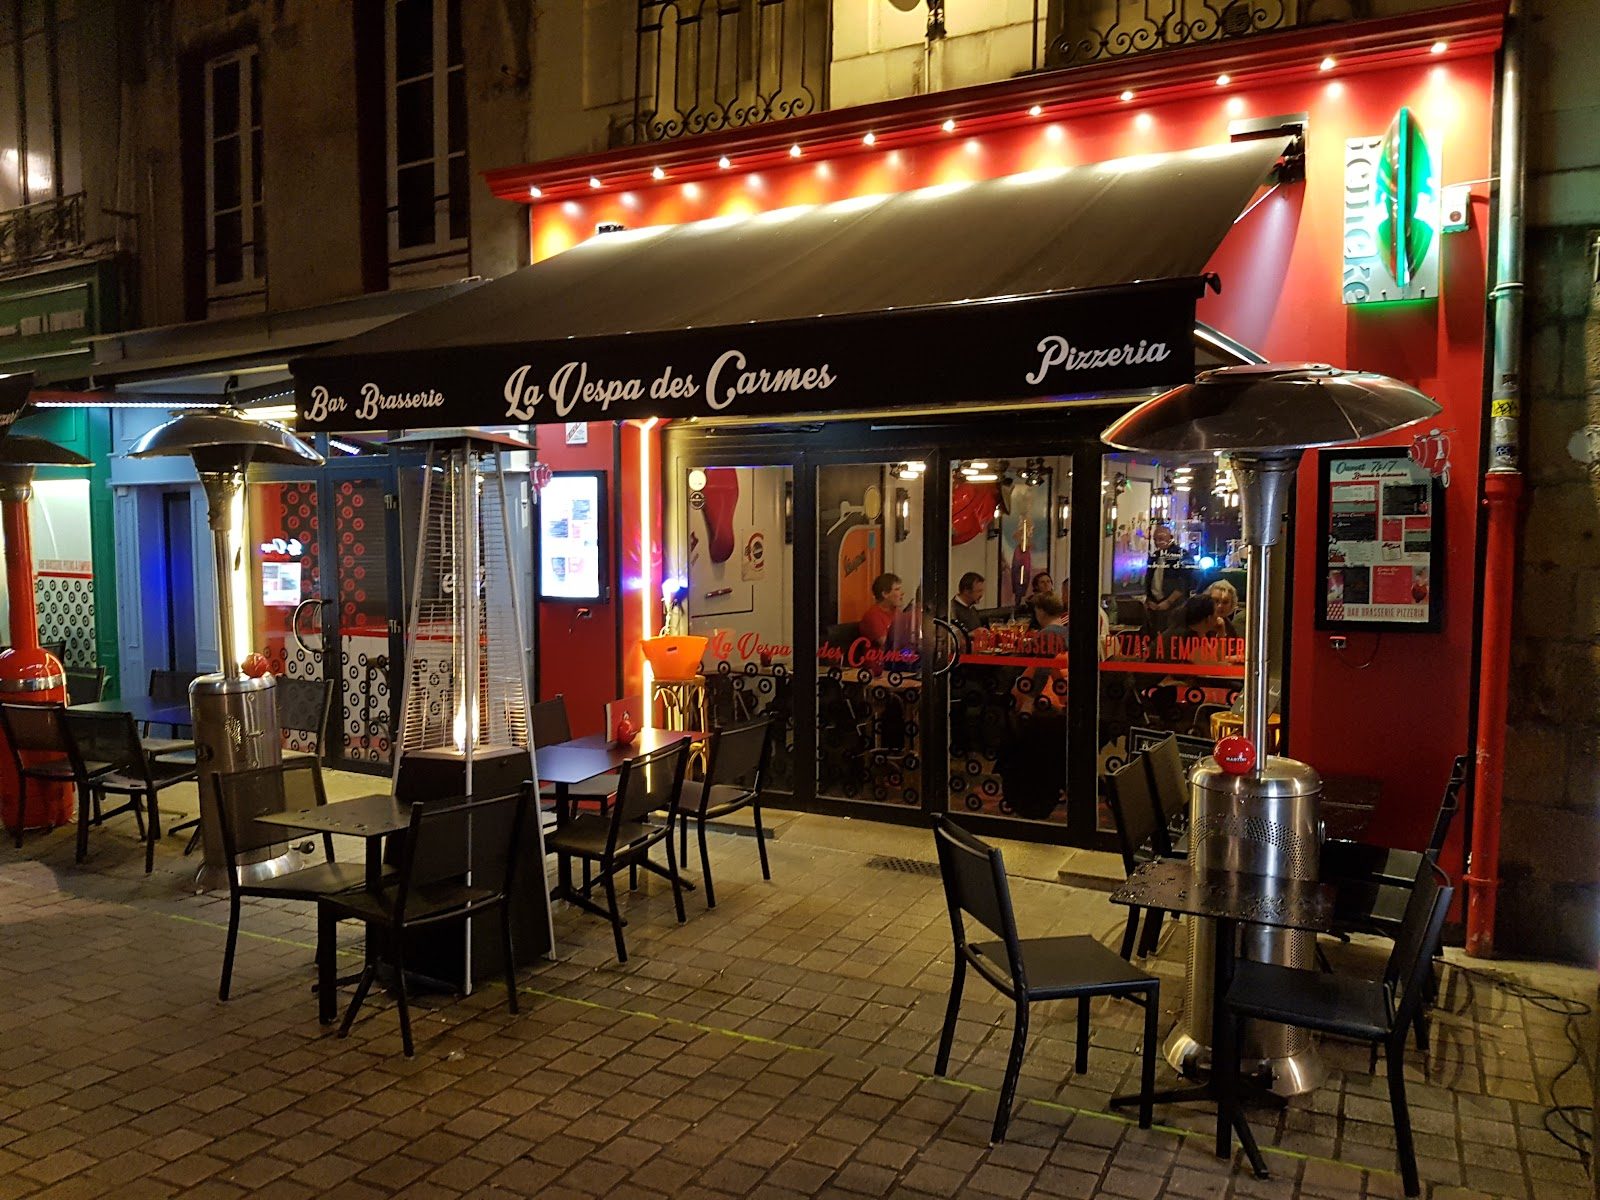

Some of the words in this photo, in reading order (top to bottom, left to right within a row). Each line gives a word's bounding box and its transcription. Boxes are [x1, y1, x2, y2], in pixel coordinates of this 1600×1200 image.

[1025, 335, 1171, 385] Pizzeria
[304, 385, 347, 422] Bar
[355, 382, 445, 421] Brasserie
[504, 365, 543, 421] La
[549, 361, 646, 417] Vespa
[650, 366, 700, 400] des
[706, 350, 837, 410] Carmes
[1396, 606, 1425, 619] PIZZERIA
[711, 631, 733, 660] La
[738, 632, 792, 661] Vespa
[816, 640, 844, 660] des
[1105, 634, 1151, 659] PIZZAS
[1156, 630, 1165, 660] À
[1170, 635, 1245, 663] EMPORTER
